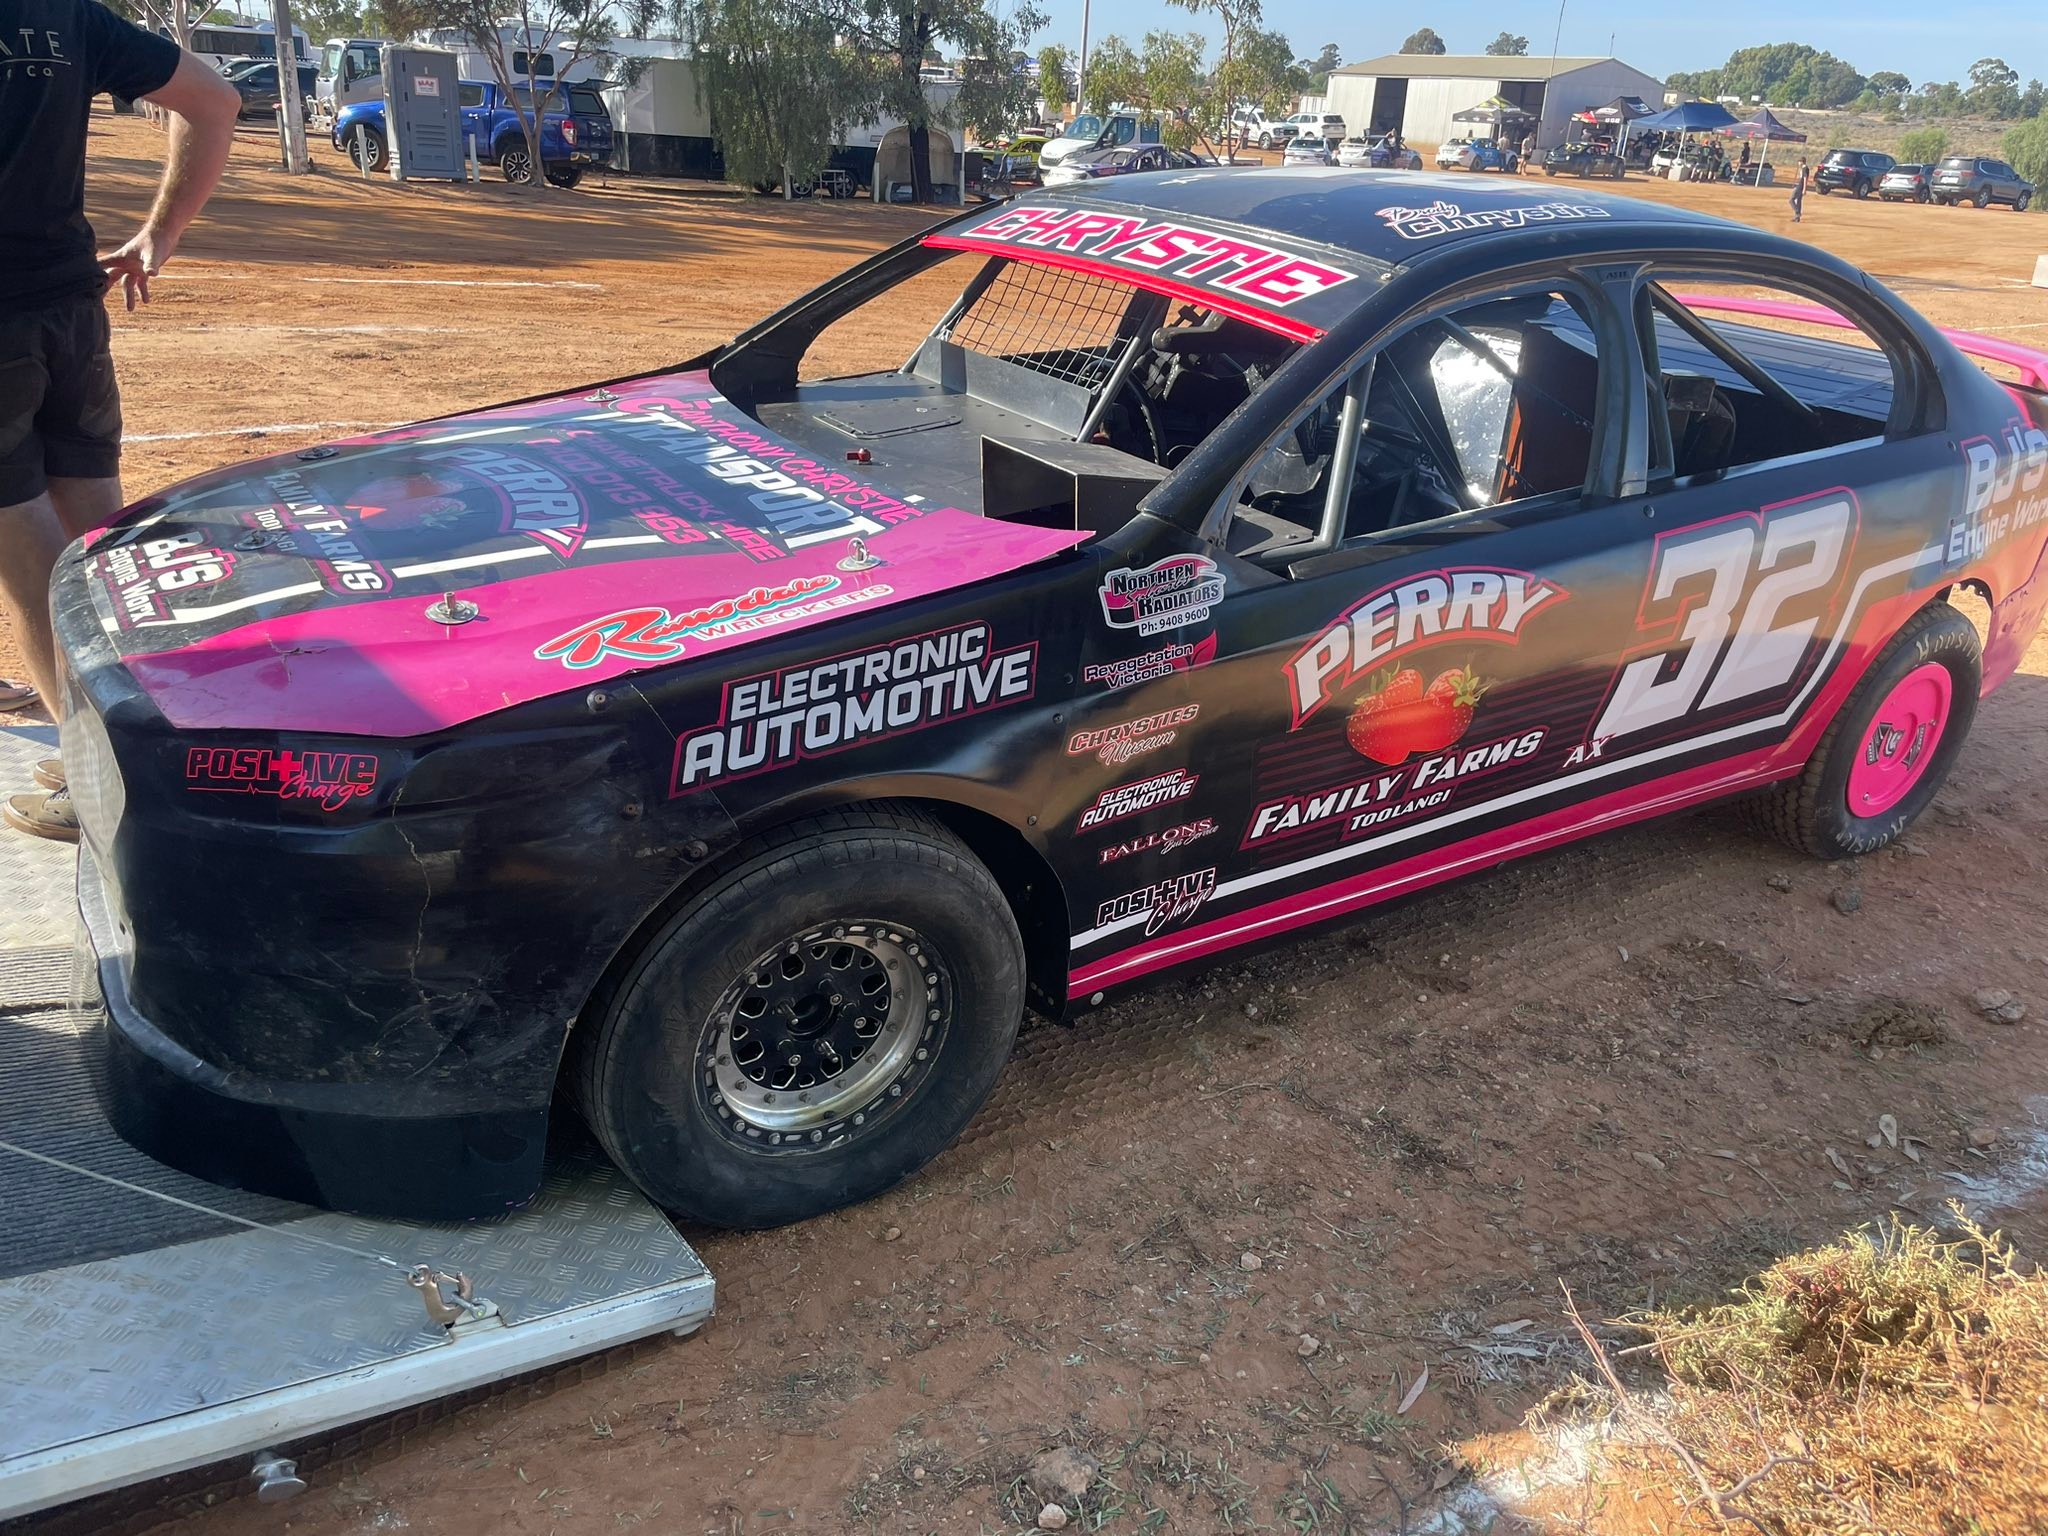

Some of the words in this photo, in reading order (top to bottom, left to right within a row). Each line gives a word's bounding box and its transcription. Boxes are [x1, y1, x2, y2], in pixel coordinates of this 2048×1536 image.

[1376, 201, 1460, 223] Brody
[1395, 203, 1611, 239] Chrystie
[961, 206, 1359, 307] CHRYSTIE
[587, 412, 886, 549] TRANSPORT
[672, 409, 796, 457] ANTHONY
[780, 459, 924, 525] CHRYSTIE
[1965, 426, 2048, 515] BJ'S
[416, 447, 580, 546] PERRY
[583, 471, 652, 506] 013
[631, 505, 709, 545] 953
[637, 467, 726, 519] TRUCK
[708, 518, 786, 561] HIRE
[264, 471, 329, 516] FAMILY
[303, 519, 383, 590] FARMS
[1947, 509, 2009, 562] Engine
[105, 543, 145, 585] Engine
[143, 531, 224, 590] BJ'S
[1112, 563, 1194, 595] NORTHERN
[122, 579, 156, 622] Worx
[536, 574, 839, 667] Ramsdale
[699, 586, 890, 639] WRECKERS
[1138, 584, 1219, 618] RADIATORS
[1141, 621, 1158, 634] Ph:
[1160, 614, 1183, 629] 9408
[1185, 607, 1208, 622] 9600
[1593, 501, 1850, 740] 32
[1085, 644, 1193, 681] Revegetation
[1294, 572, 1555, 715] PERRY
[730, 626, 986, 722] ELECTRONIC
[1106, 662, 1173, 689] Victoria
[682, 649, 1032, 785] AUTOMOTIVE
[1069, 704, 1200, 752] CHRYSTIES
[1100, 730, 1176, 766] Museum
[1562, 736, 1610, 768] AX
[278, 769, 375, 812] Charge
[1081, 779, 1194, 828] AUTOMOTIVE
[1099, 771, 1183, 807] ELECTRONIC
[1250, 773, 1402, 840] FAMILY
[1411, 731, 1544, 791] FARMS
[1350, 789, 1452, 831] TOOLANGI
[1100, 818, 1213, 863] FALLONS
[1145, 886, 1214, 937] Charge
